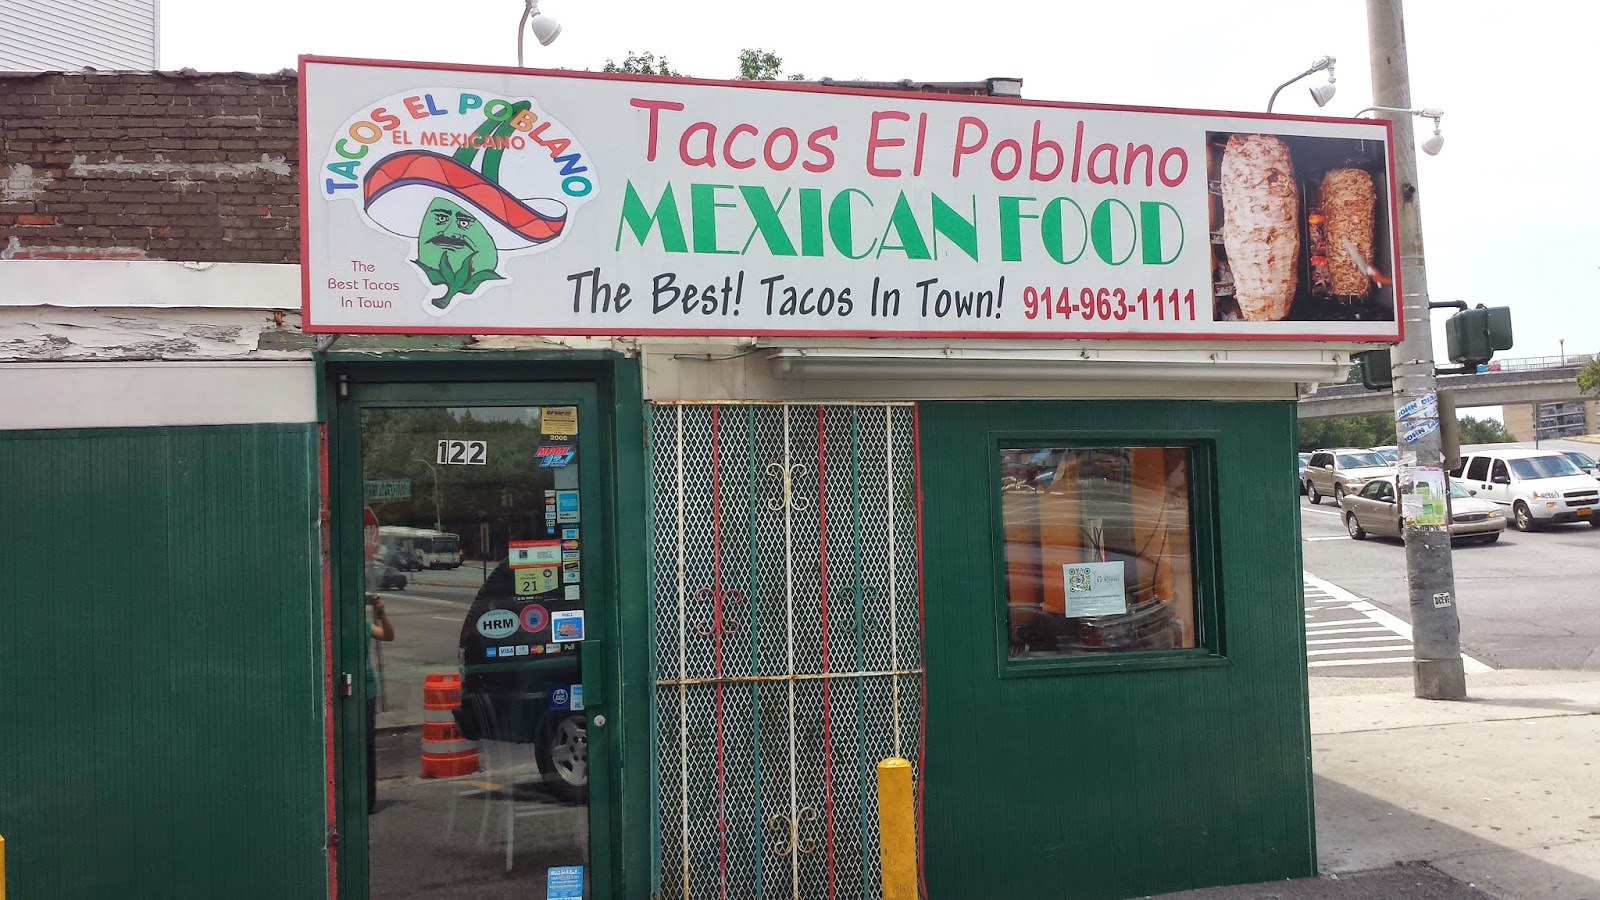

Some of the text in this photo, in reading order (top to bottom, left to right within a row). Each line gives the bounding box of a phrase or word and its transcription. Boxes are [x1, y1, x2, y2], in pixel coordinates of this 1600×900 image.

[326, 93, 592, 197] TACOS EL POBLANO
[392, 130, 526, 151] EL MEXICANO
[630, 98, 1188, 187] Tacos El Poblano
[616, 179, 1184, 266] MEXICAN FOOD
[351, 260, 375, 272] The
[328, 278, 400, 291] Best Tacos
[567, 266, 1005, 320] The Best! Tacos In Town!
[341, 297, 392, 309] In Town
[1023, 286, 1196, 321] 914-963-1111
[439, 441, 485, 463] 122
[523, 581, 537, 592] 21
[483, 618, 513, 630] HRM
